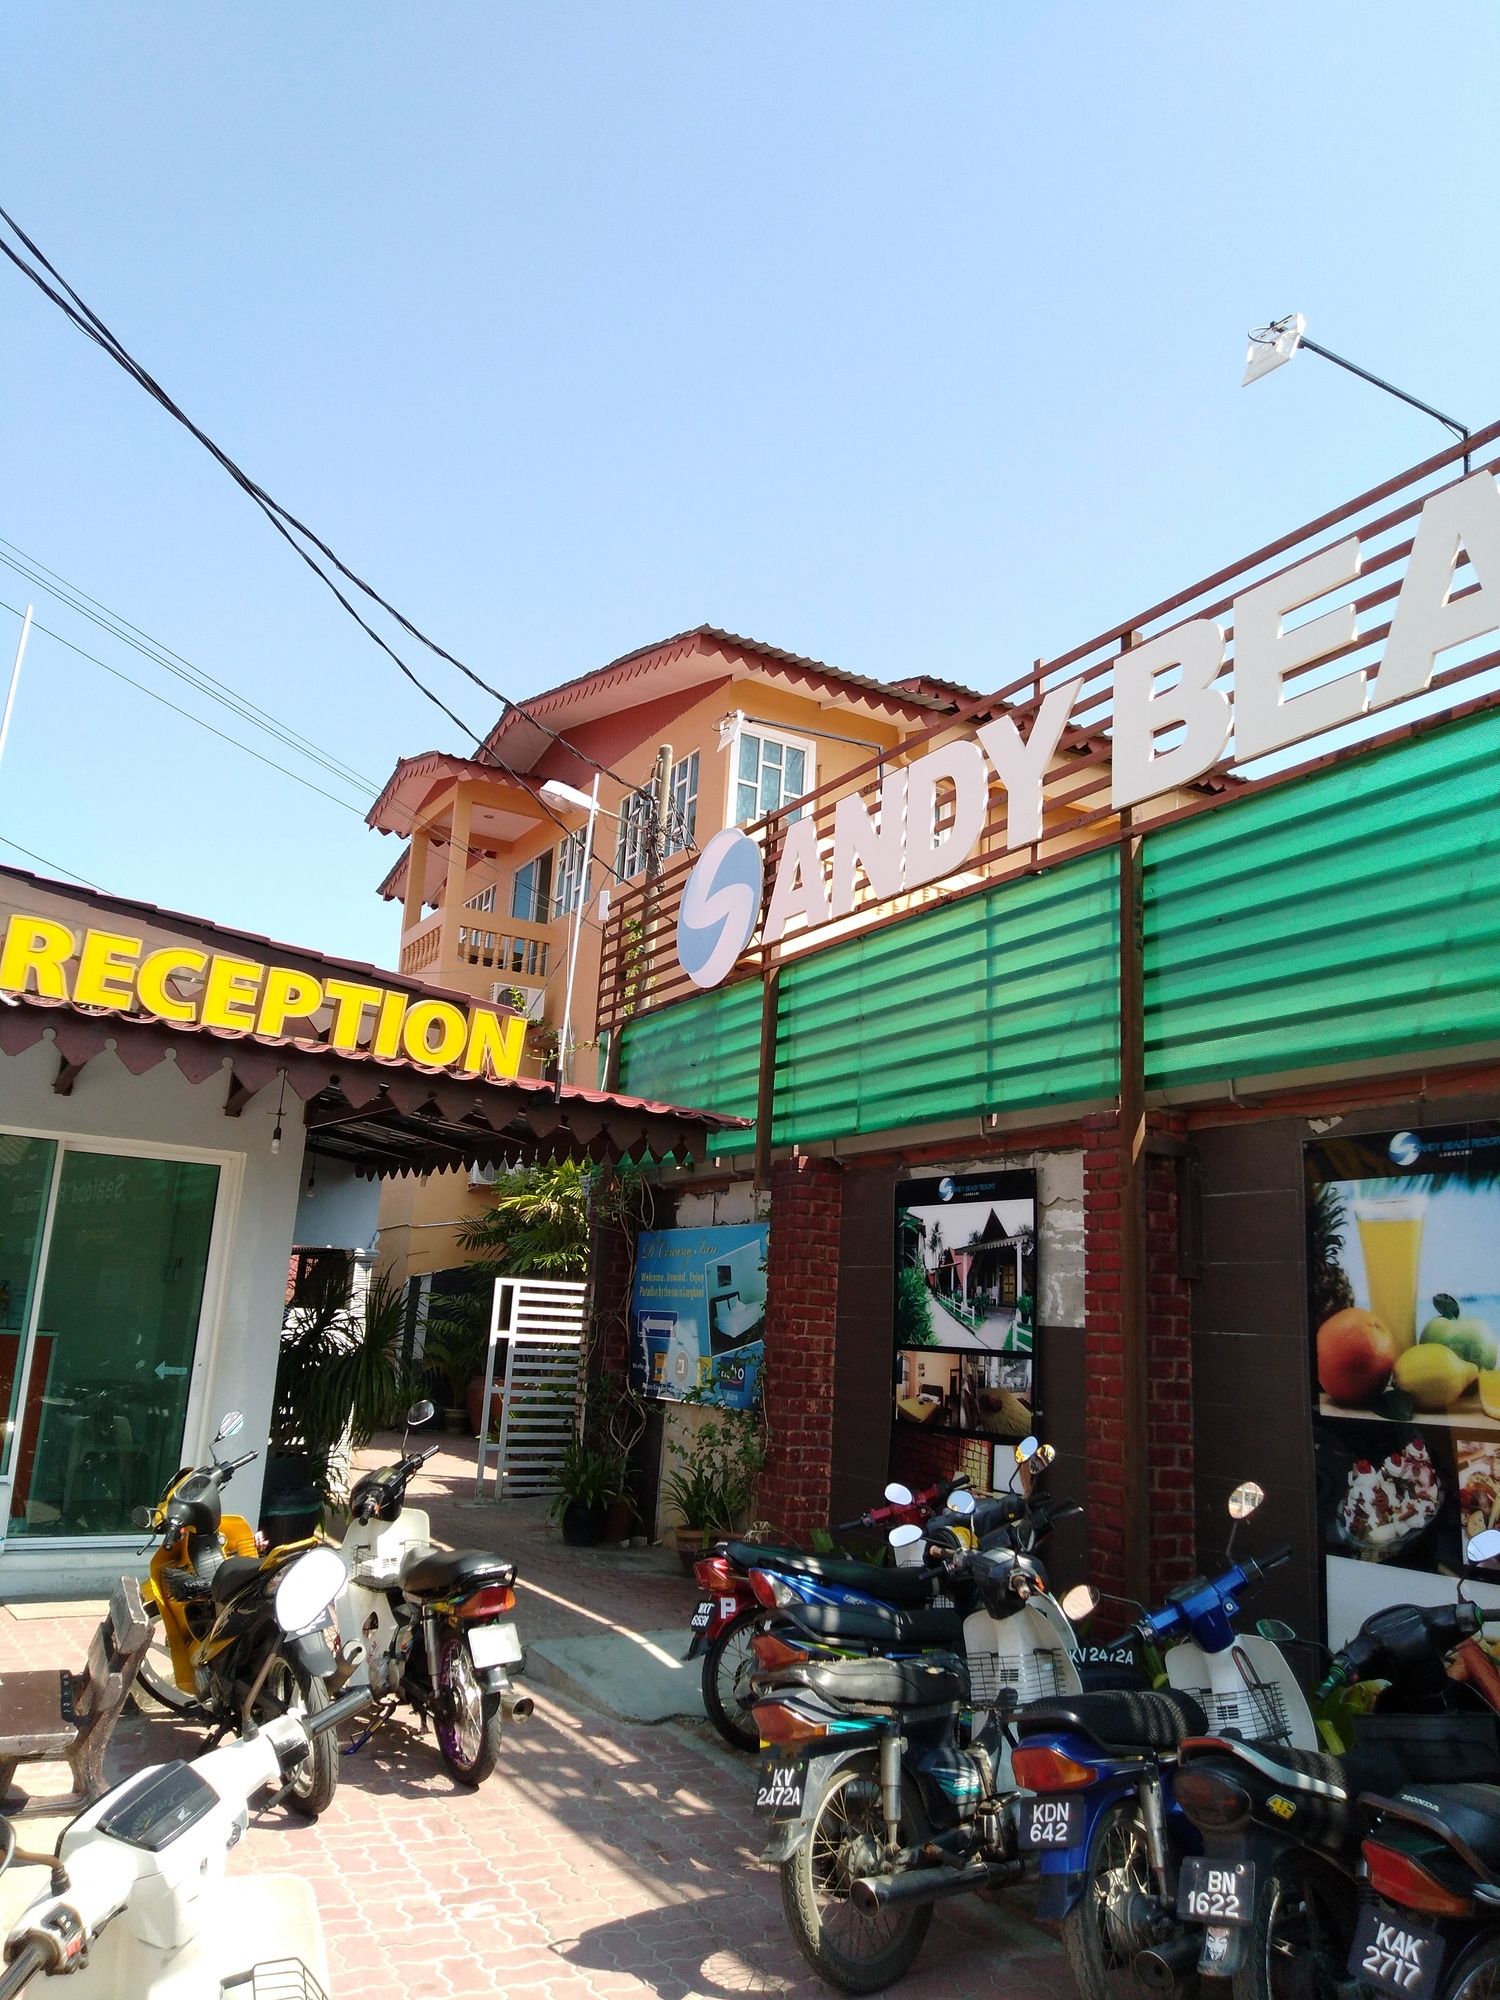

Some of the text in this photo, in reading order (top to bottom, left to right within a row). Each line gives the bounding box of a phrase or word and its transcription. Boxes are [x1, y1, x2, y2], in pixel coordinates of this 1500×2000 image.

[1112, 469, 1500, 810] BEA
[0, 914, 528, 1079] RECEPTION
[720, 1597, 736, 1619] P
[1069, 1648, 1086, 1663] KV
[773, 1767, 794, 1785] KV
[757, 1787, 800, 1807] 2472A
[1400, 1793, 1440, 1813] HONDA
[1033, 1801, 1069, 1824] KDN
[1029, 1823, 1067, 1843] 642
[1208, 1871, 1236, 1895] BN
[1187, 1892, 1239, 1918] 1622
[1375, 1925, 1422, 1960] KAK
[1362, 1947, 1421, 1987] 2717
